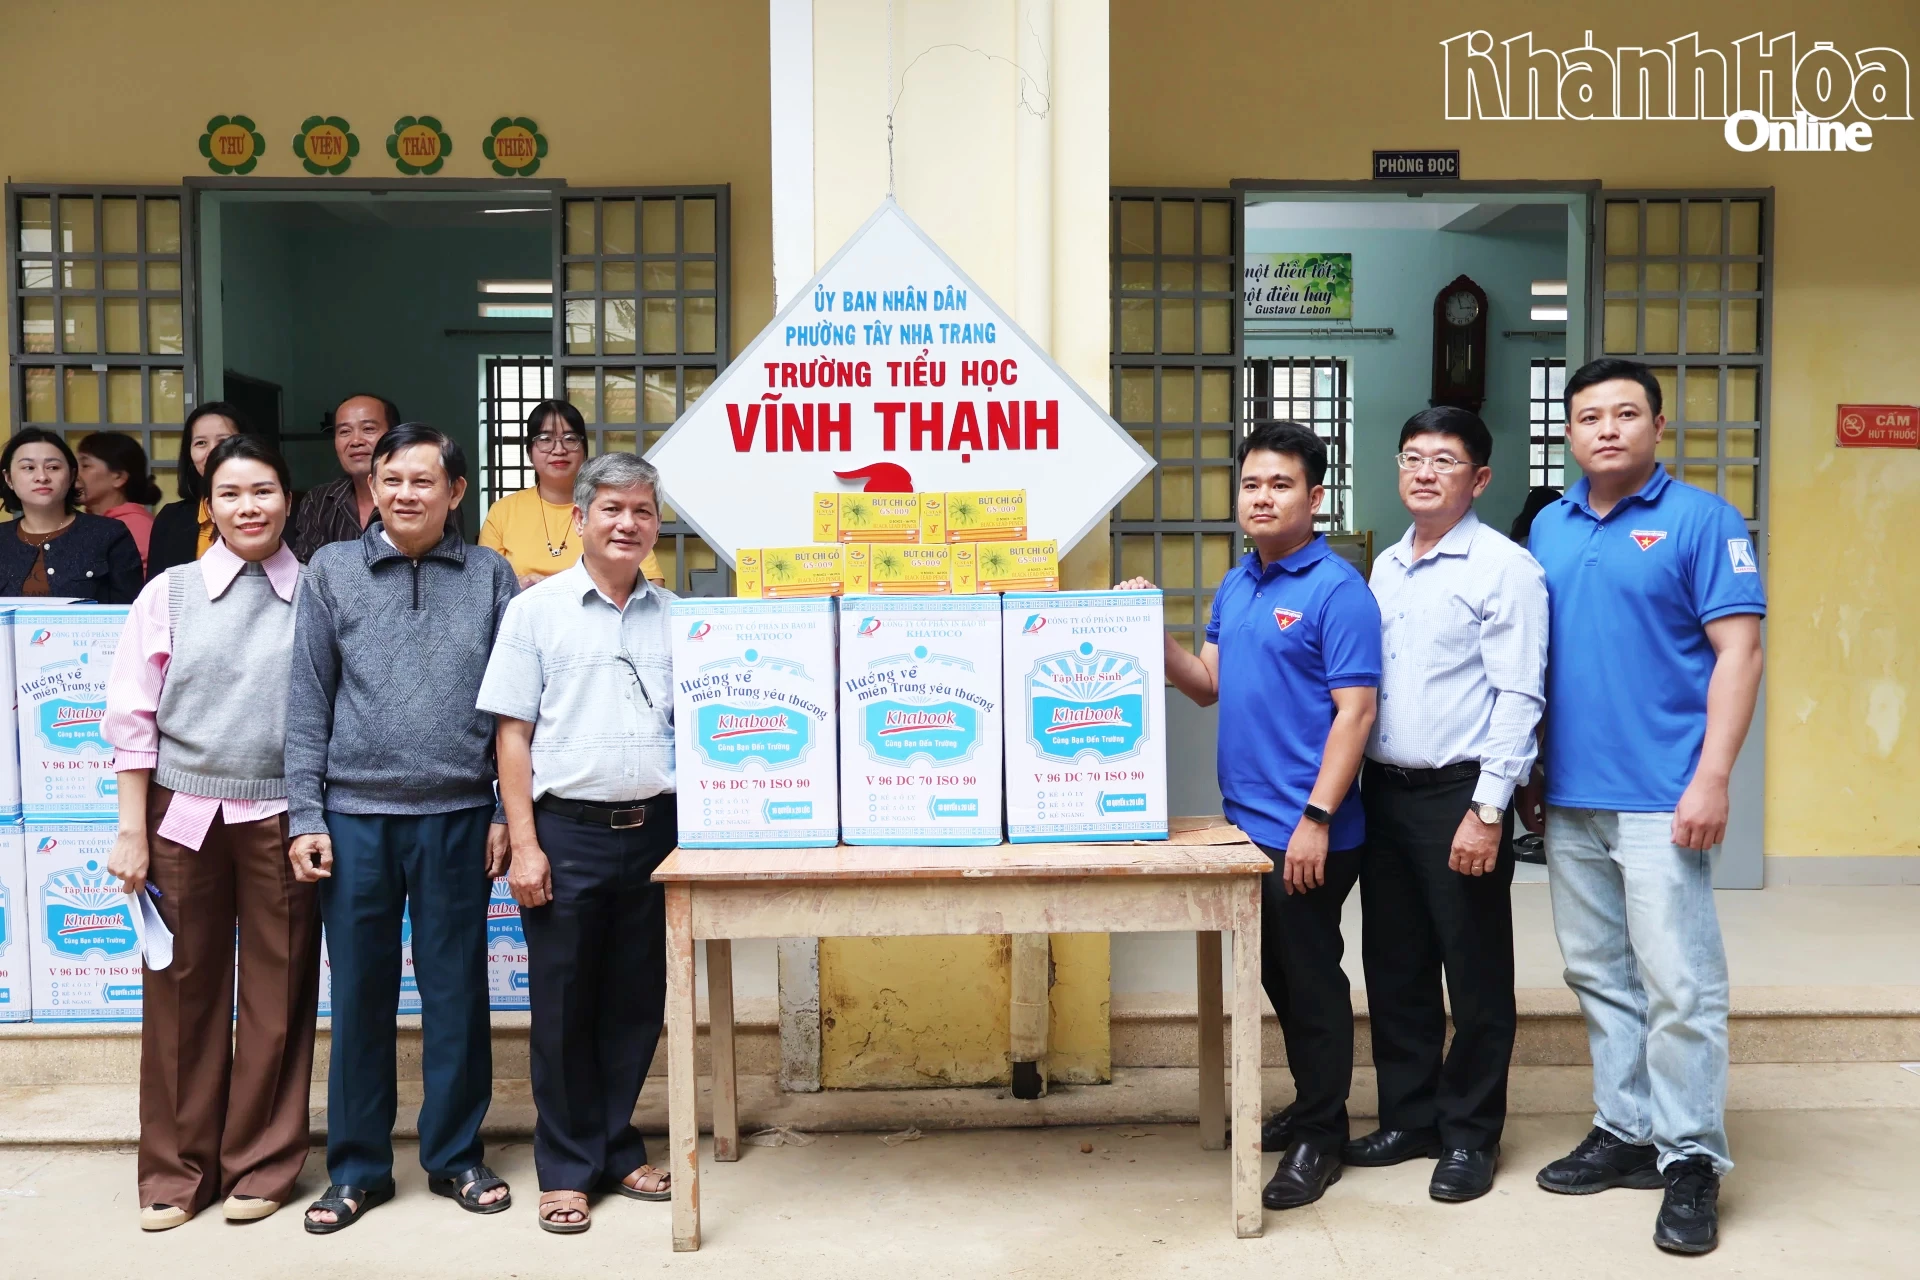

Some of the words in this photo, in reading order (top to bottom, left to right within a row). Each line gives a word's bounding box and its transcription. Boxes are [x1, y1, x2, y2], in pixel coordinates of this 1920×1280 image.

[219, 133, 245, 155] THƯ
[310, 130, 342, 160] VIỆN
[403, 132, 436, 156] THÂN
[496, 133, 534, 161] THIỆN
[1379, 155, 1424, 173] PHÒNG
[1427, 157, 1455, 175] ĐỌC
[1273, 260, 1307, 278] điều
[1311, 260, 1336, 282] tốt,
[814, 283, 836, 312] ỦY
[843, 290, 877, 312] BAN
[883, 285, 927, 312] NHÂN
[933, 284, 967, 311] DÂN
[1266, 285, 1300, 302] điều
[1303, 286, 1332, 305] hay
[1299, 304, 1331, 314] Lebon
[785, 319, 856, 346] PHƯỜNG
[863, 319, 893, 345] TÂY
[900, 323, 934, 345] NHA
[940, 322, 996, 345] TRANG
[764, 355, 872, 388] TRƯỜNG
[886, 348, 946, 388] TIỂU
[961, 358, 1018, 392] HỌC
[1875, 411, 1910, 426] CẤM
[726, 392, 852, 453] VĨNH
[874, 400, 1059, 463] THẠNH
[1868, 428, 1885, 439] HÚT
[1888, 428, 1917, 440] THUỐC
[736, 632, 792, 640] KHATOCO
[906, 630, 962, 638] KHATOCO
[1072, 626, 1128, 634] KHATOCO
[20, 672, 63, 694] Hướng
[68, 668, 82, 680] về
[680, 672, 730, 694] Hướng
[735, 670, 754, 682] về
[845, 670, 895, 692] Hướng
[900, 665, 918, 678] về
[1052, 673, 1072, 684] Tập
[1076, 672, 1095, 683] Học
[1098, 672, 1122, 681] Sinh
[32, 686, 58, 700] miền
[60, 682, 90, 692] Trung
[94, 681, 106, 690] yê
[692, 686, 721, 702] miền
[724, 686, 760, 699] Trung
[764, 688, 786, 700] yêu
[788, 694, 828, 721] thương
[858, 684, 888, 701] miền
[890, 682, 926, 694] Trung
[929, 684, 951, 694] yêu
[955, 688, 994, 713] thương
[58, 707, 106, 719] Khabo
[886, 711, 956, 725] Khabook
[1054, 706, 1122, 722] Khabook
[718, 714, 788, 728] Khabook
[885, 740, 902, 748] Cùng
[919, 738, 932, 746] Đến
[935, 739, 958, 748] Trường
[1052, 736, 1070, 745] Cùng
[1072, 736, 1084, 744] Bạn
[1086, 735, 1100, 743] Đến
[1102, 735, 1124, 744] Trường
[718, 744, 734, 752] Cùng
[752, 742, 764, 750] Đến
[768, 742, 790, 751] Trường
[68, 761, 84, 769] DC
[866, 776, 874, 786] V
[878, 776, 892, 786] 96
[896, 776, 915, 786] DC
[919, 776, 932, 786] 70
[937, 776, 959, 786] ISO
[963, 776, 976, 786] 90
[1034, 774, 1042, 783] V
[1047, 774, 1060, 782] 96
[1065, 772, 1083, 782] DC
[1087, 772, 1100, 782] 70
[1105, 772, 1127, 781] ISO
[1131, 771, 1144, 780] 90
[700, 780, 708, 790] V
[712, 780, 726, 790] 96
[730, 780, 748, 790] DC
[752, 780, 766, 789] 70
[770, 778, 792, 788] ISO
[796, 778, 810, 788] 90
[63, 886, 80, 894] Tập
[84, 886, 100, 894] Học
[65, 914, 124, 926] Khabook
[502, 954, 514, 962] 70
[49, 968, 57, 976] V
[60, 968, 72, 976] 96
[76, 968, 90, 976] DC
[94, 968, 106, 976] 70
[110, 967, 128, 976] ISO
